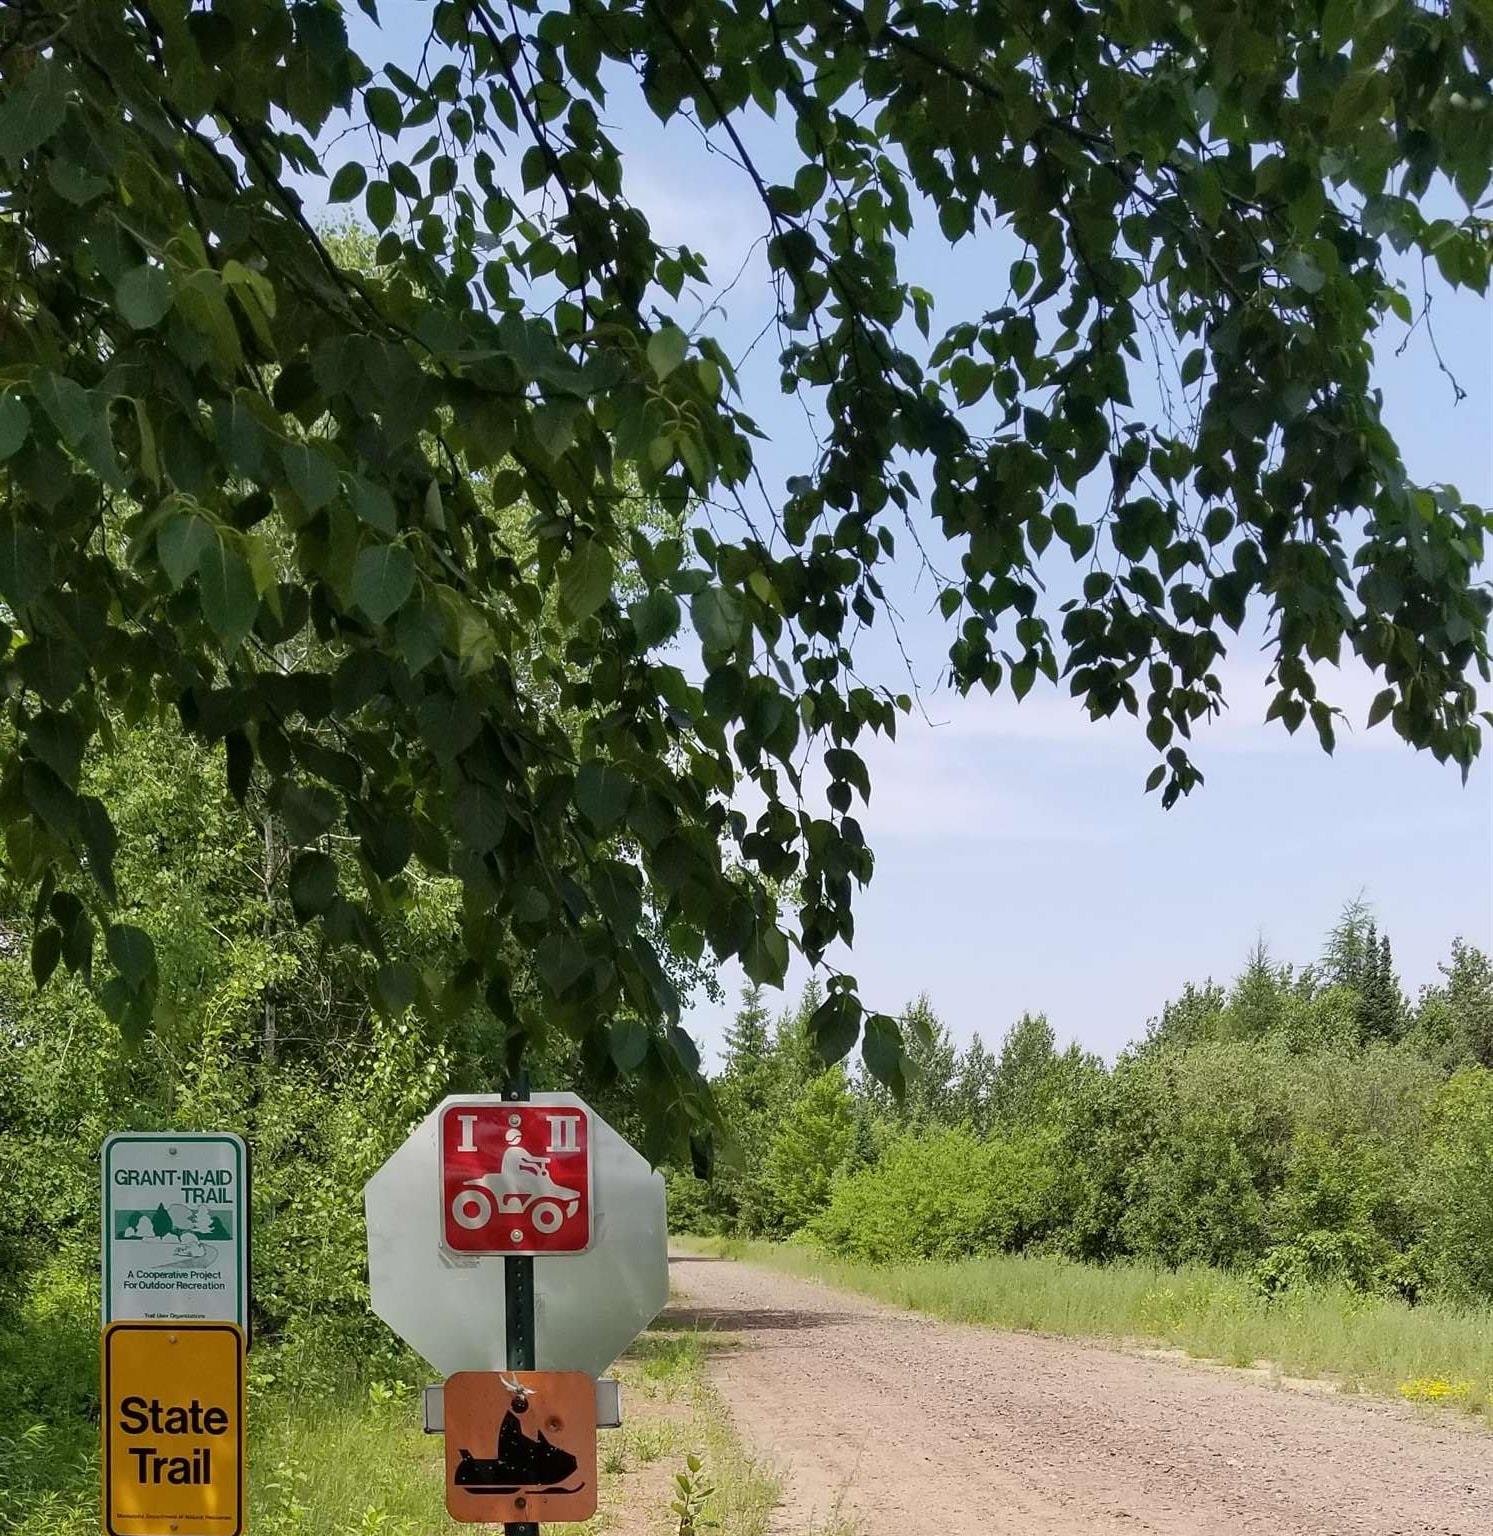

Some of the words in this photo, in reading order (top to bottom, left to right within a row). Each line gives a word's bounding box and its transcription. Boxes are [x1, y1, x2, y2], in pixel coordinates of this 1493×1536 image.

[181, 1188, 233, 1204] TRAIL
[127, 1270, 134, 1278] A
[136, 1270, 188, 1280] Cooperative
[190, 1270, 221, 1280] Project
[123, 1281, 137, 1289] For
[138, 1281, 175, 1290] Outdoor
[176, 1281, 225, 1290] Recreation
[120, 1396, 229, 1435] State
[128, 1448, 210, 1484] Trail
